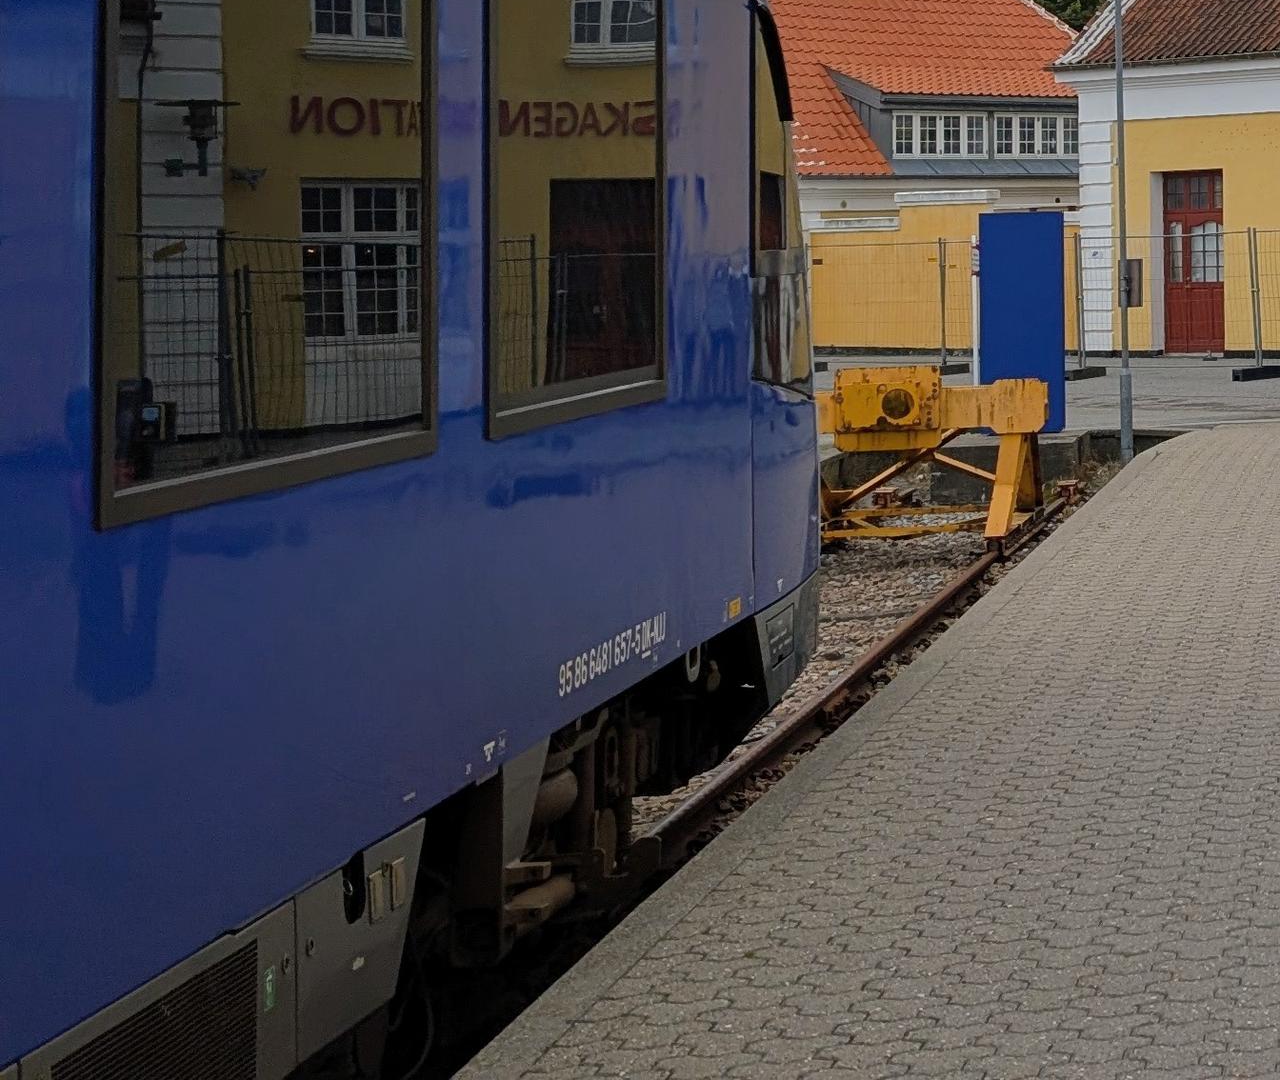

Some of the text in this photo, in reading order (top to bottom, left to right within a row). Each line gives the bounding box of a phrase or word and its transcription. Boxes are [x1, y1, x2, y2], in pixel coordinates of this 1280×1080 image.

[558, 659, 573, 697] 95
[574, 652, 588, 689] 86
[588, 639, 613, 680] 6481
[614, 623, 641, 666] 657-5
